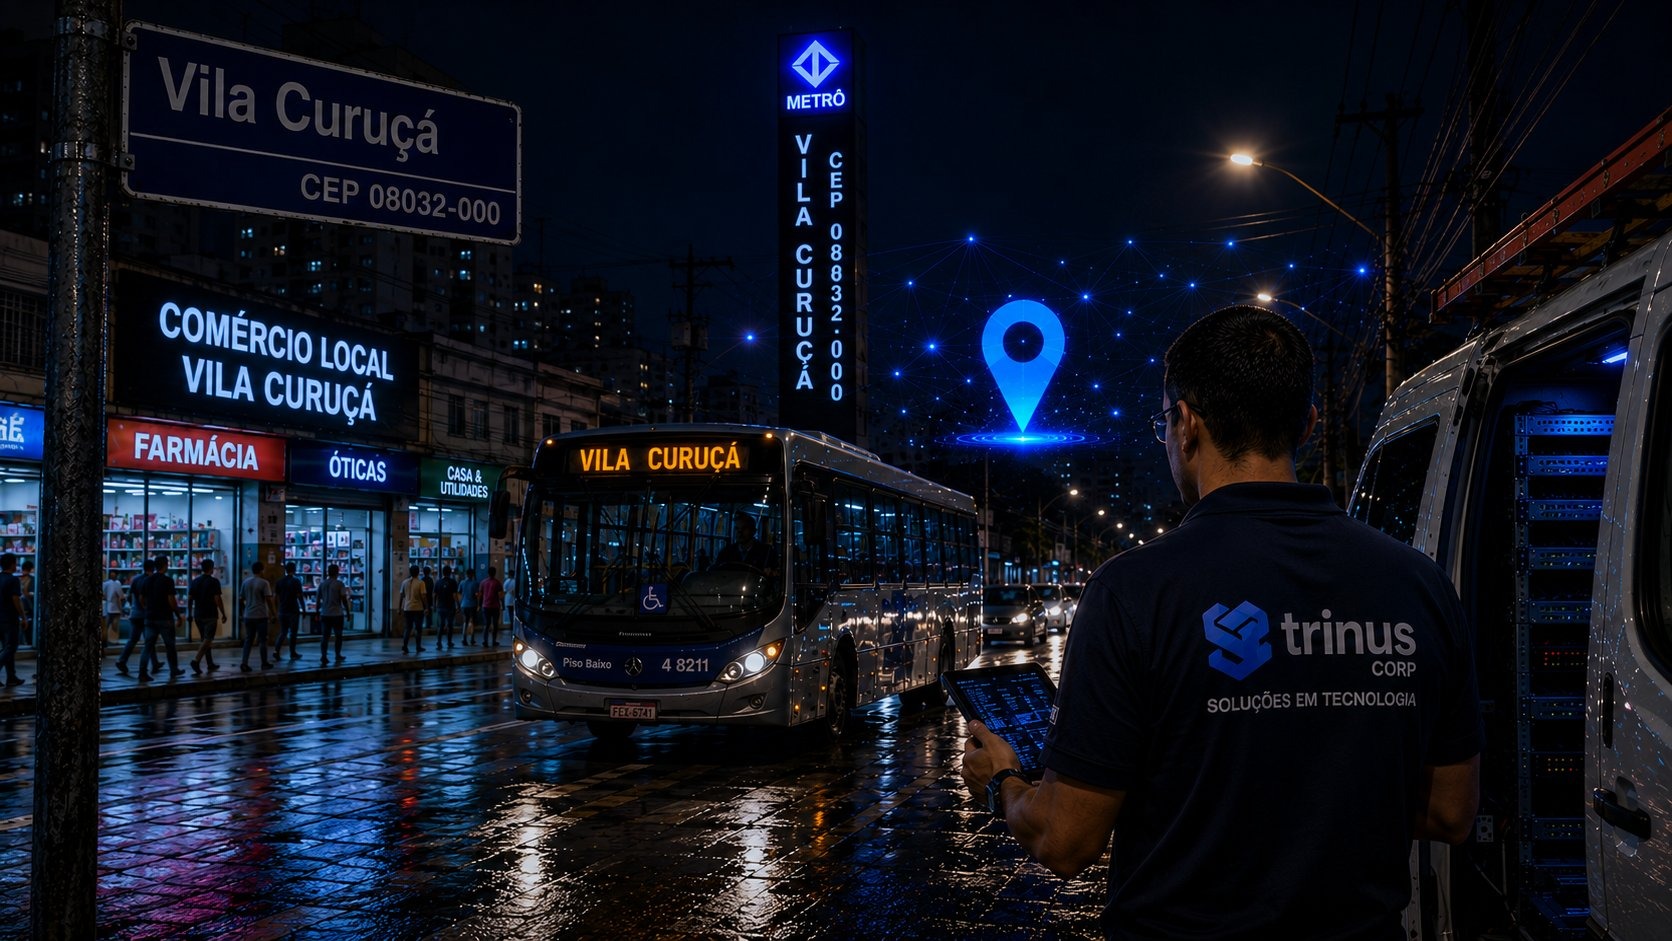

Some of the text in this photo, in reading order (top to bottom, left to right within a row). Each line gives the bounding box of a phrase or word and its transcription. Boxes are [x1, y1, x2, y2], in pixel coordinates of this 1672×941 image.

[157, 56, 440, 162] Vila Curuçá
[786, 88, 846, 110] METRÔ
[829, 151, 843, 208] CEP
[300, 173, 501, 225] CEP 08032-000
[795, 134, 814, 390] VILA CURUÇÁ
[159, 301, 394, 381] COMÉRCIO LOCAL
[182, 355, 377, 426] VILA CURUÇÁ
[134, 432, 259, 471] FARMÁCIA
[329, 450, 387, 483] ÓTICAS
[580, 441, 741, 473] VILA CURUÇÁ
[440, 481, 488, 499] UTILIDADES
[447, 466, 482, 484] CASA &
[1281, 608, 1417, 656] trinus
[563, 657, 612, 670] Piso Baixo
[661, 658, 709, 672] 4 8211
[1372, 660, 1416, 677] CORP
[1207, 690, 1417, 714] SOLUÇÕES EM TECNOLOGIA
